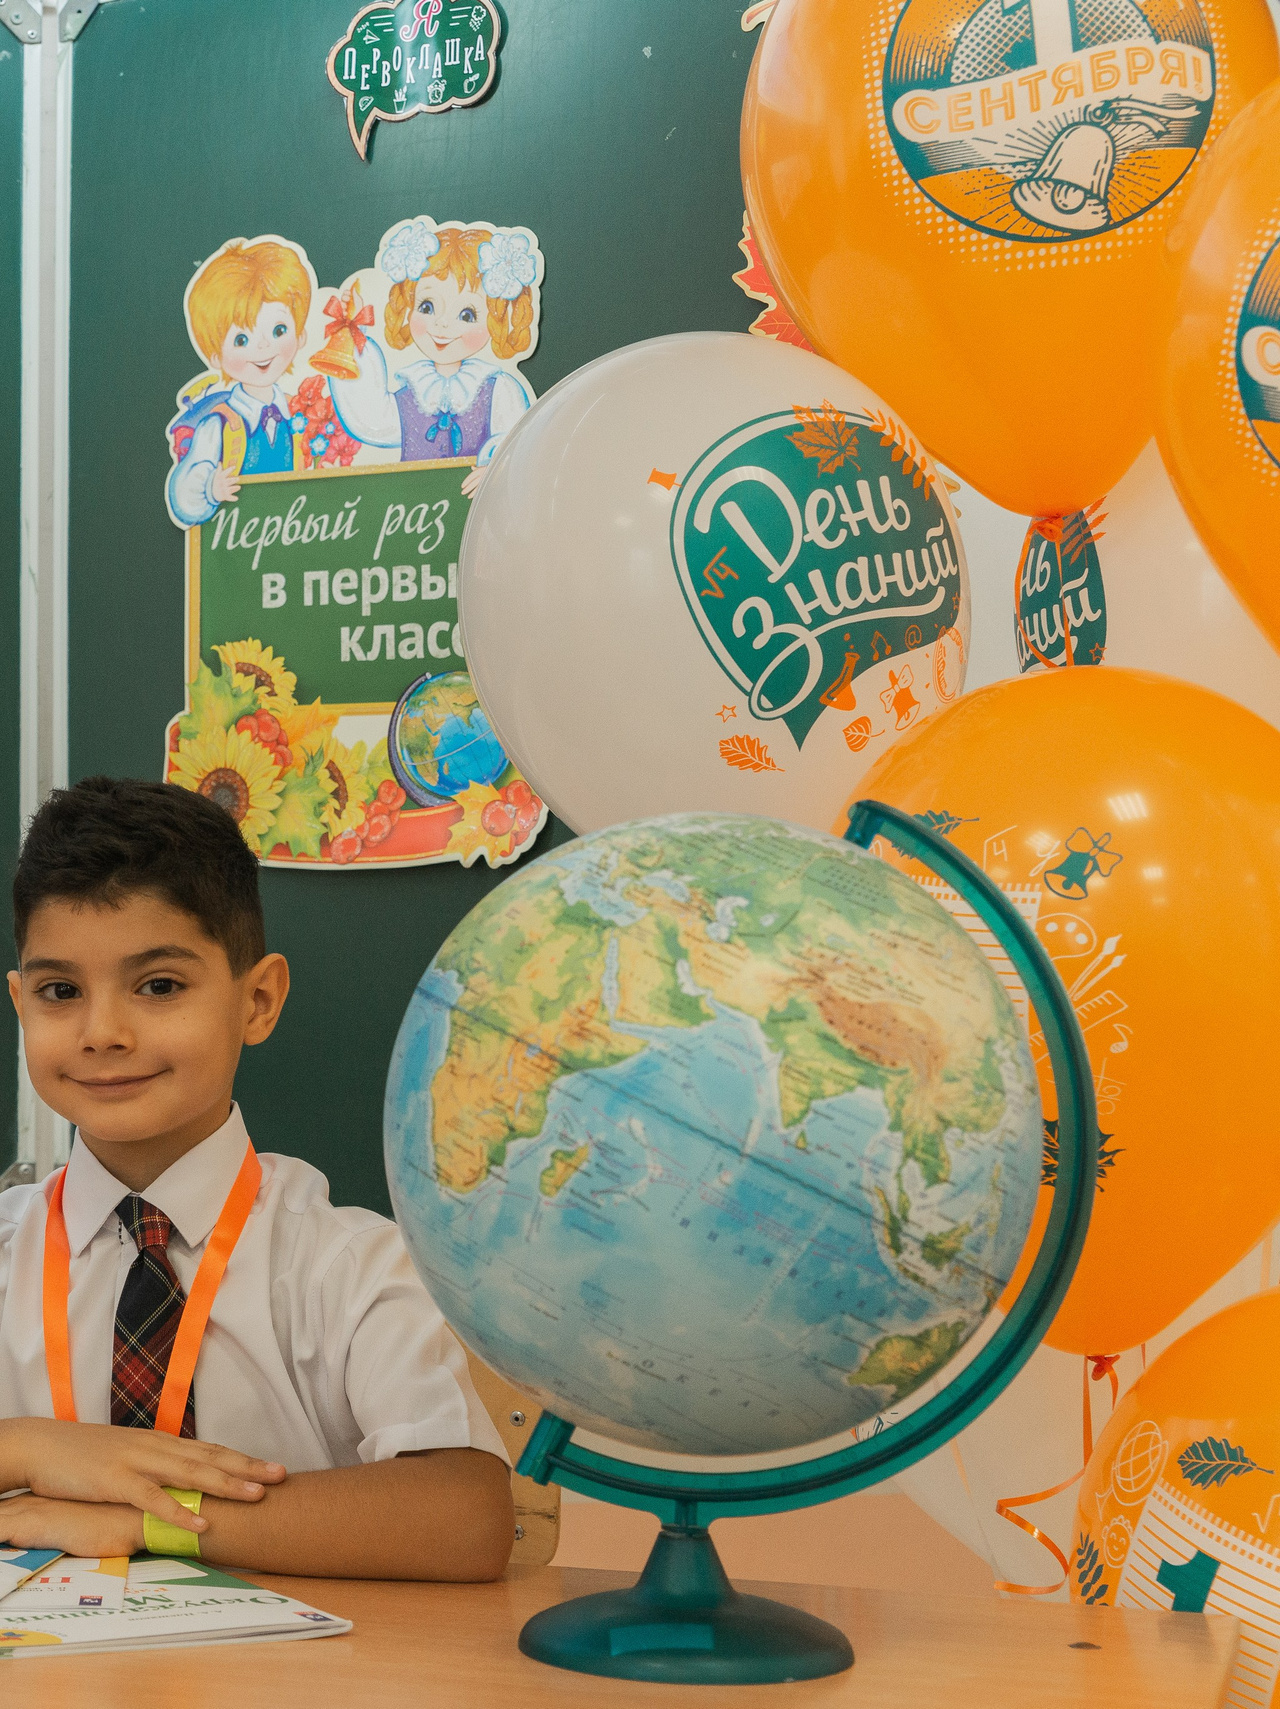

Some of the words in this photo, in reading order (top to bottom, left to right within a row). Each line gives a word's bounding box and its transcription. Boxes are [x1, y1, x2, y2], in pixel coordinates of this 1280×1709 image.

[400, 0, 442, 41] Я
[343, 34, 485, 90] ПЕРВОКЛАШКА
[903, 46, 1205, 134] СЕНТЯБРЯ!
[211, 494, 362, 570] Первый
[373, 499, 450, 560] раз
[693, 465, 911, 583] День
[262, 572, 287, 608] в
[303, 563, 458, 616] первы
